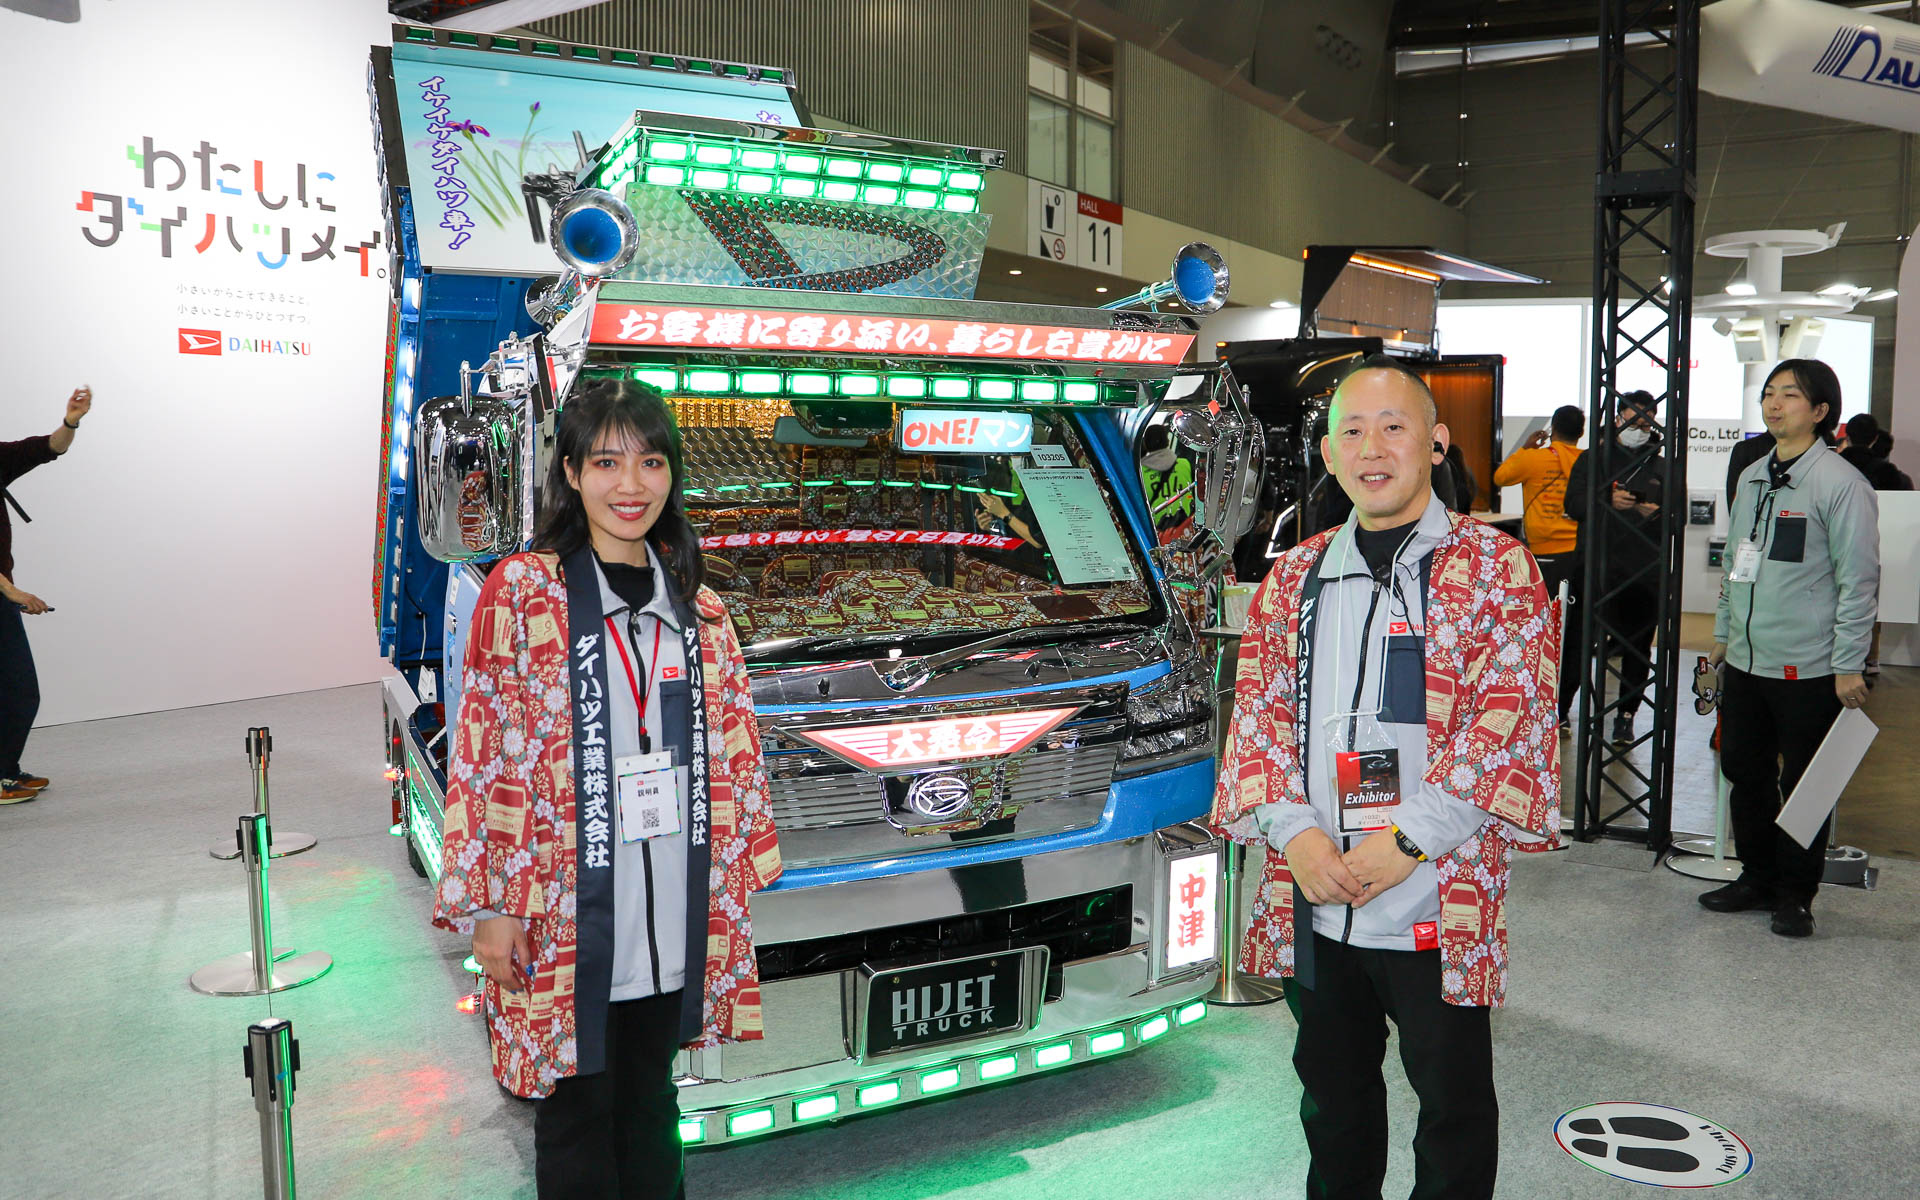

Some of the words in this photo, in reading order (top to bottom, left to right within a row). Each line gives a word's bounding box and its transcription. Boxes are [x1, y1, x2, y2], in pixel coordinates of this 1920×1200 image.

[126, 135, 336, 212] わたしに
[1080, 198, 1099, 214] HALL
[1088, 222, 1111, 266] 11
[229, 337, 311, 356] DAIHATSU
[616, 309, 1172, 361] お客様に寄り添い、暮らしを豊かに
[1718, 427, 1740, 440] Ltd
[575, 632, 611, 869] ダイハツ工業株式会社
[684, 626, 706, 847] ダイハツ工業株式会社
[1345, 791, 1396, 805] Exhibitor
[1177, 873, 1207, 948] 中津
[892, 974, 996, 1026] HIJET
[893, 1009, 993, 1040] TRUCK
